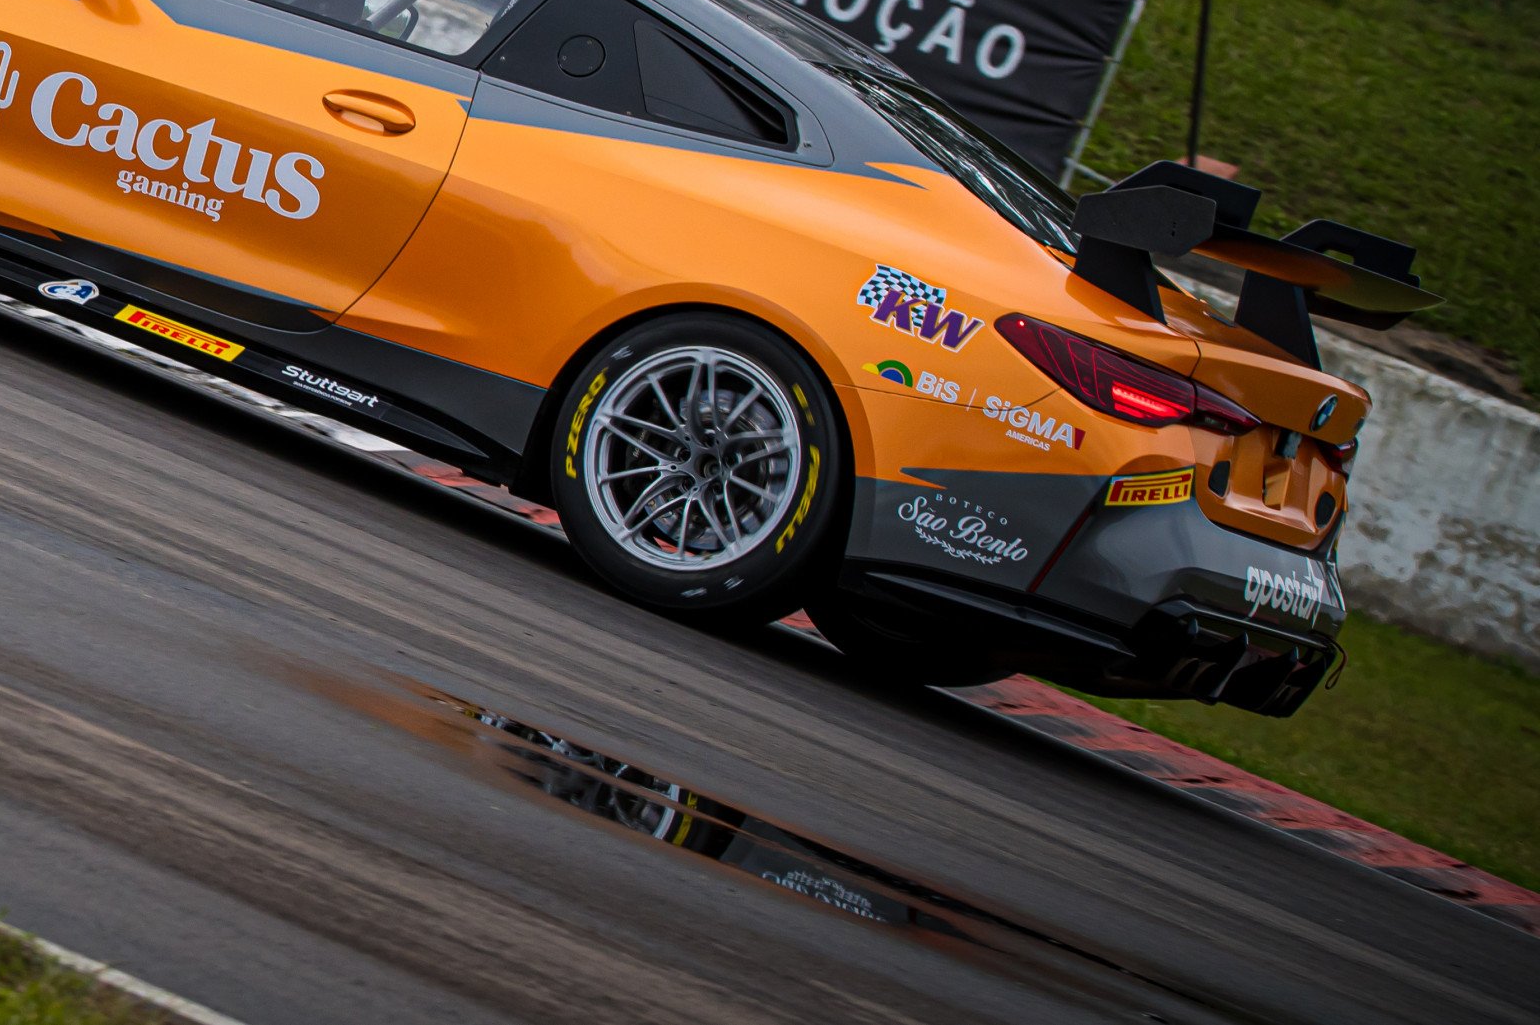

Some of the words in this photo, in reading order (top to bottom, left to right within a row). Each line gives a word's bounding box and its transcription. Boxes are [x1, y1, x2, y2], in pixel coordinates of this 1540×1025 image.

[31, 71, 325, 220] Cactus
[116, 169, 224, 222] gaming
[127, 311, 231, 357] PIRELLI
[868, 286, 984, 352] KW
[281, 365, 379, 408] Stuttgart
[1005, 429, 1051, 452] AMERICAS
[935, 493, 1009, 526] BOTECO
[1109, 473, 1191, 505] PIRELLI
[897, 495, 948, 531] São
[949, 515, 1029, 561] Bento
